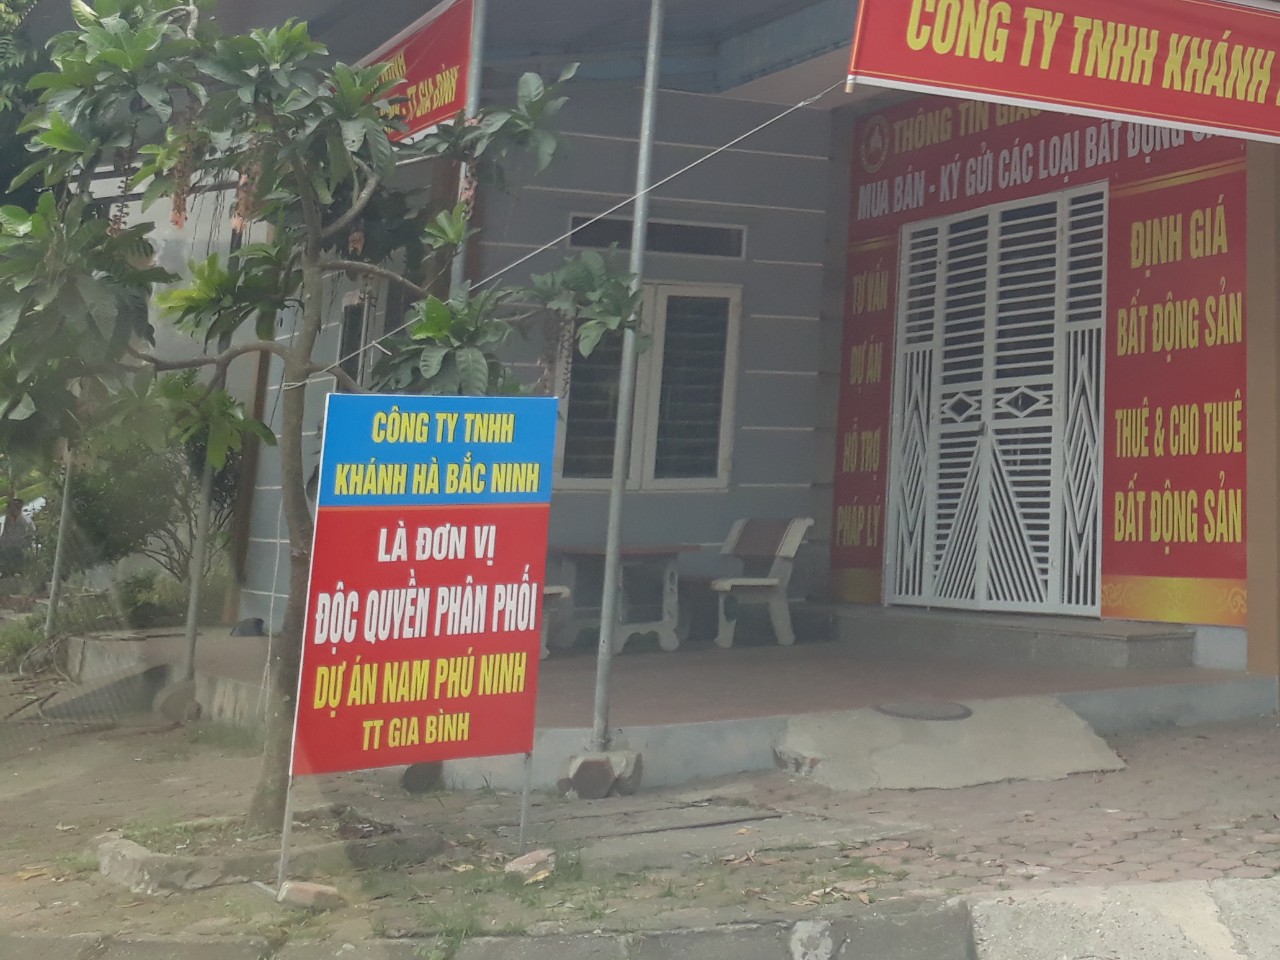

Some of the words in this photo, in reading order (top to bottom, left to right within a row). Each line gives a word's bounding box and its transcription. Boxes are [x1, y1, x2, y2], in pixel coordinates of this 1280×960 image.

[1019, 7, 1064, 70] TY
[1069, 16, 1159, 86] TNHH
[1162, 30, 1275, 104] KHÁNH
[893, 107, 953, 154] THÔNG
[959, 100, 989, 136] TIN
[995, 102, 1042, 127] GI
[857, 179, 888, 220] MUA
[893, 165, 925, 213] BÁN
[939, 153, 961, 203] KÝ
[965, 142, 994, 197] GỬI
[998, 137, 1033, 190] CÁC
[1039, 130, 1080, 183] LOẠI
[1130, 213, 1183, 278] ĐỊNH
[1190, 194, 1228, 259] GIÁ
[1117, 288, 1149, 356] BẤT
[1152, 291, 1200, 363] ĐỘNG
[1205, 276, 1243, 347] SẢN
[372, 405, 428, 443] CÔNG
[436, 412, 460, 443] TY
[464, 413, 515, 443] TNHH
[1115, 396, 1150, 458] THUÊ
[1154, 406, 1165, 457] &
[1170, 403, 1200, 456] CHO
[1204, 388, 1243, 454] THUÊ
[334, 457, 408, 496] KHÁNH
[412, 456, 440, 494] HÀ
[446, 452, 486, 495] BẮC
[491, 463, 540, 493] NINH
[378, 520, 407, 562] LÀ
[415, 522, 468, 561] ĐƠN
[474, 525, 496, 566] VỊ
[1114, 472, 1146, 542] BẤT
[1150, 479, 1198, 555] ĐỘNG
[1203, 470, 1242, 543] SẢN
[314, 581, 359, 654] ĐỘC
[363, 569, 431, 644] QUYỀN
[434, 576, 488, 637] PHÂN
[492, 564, 538, 632] PHỐI
[313, 662, 347, 717] DỰ
[348, 654, 378, 706] ÁN
[382, 659, 431, 703] NAM
[433, 647, 475, 700] PHÚ
[478, 652, 527, 693] NINH
[362, 720, 384, 751] TT
[388, 717, 420, 747] GIA
[424, 709, 470, 744] BÌNH
